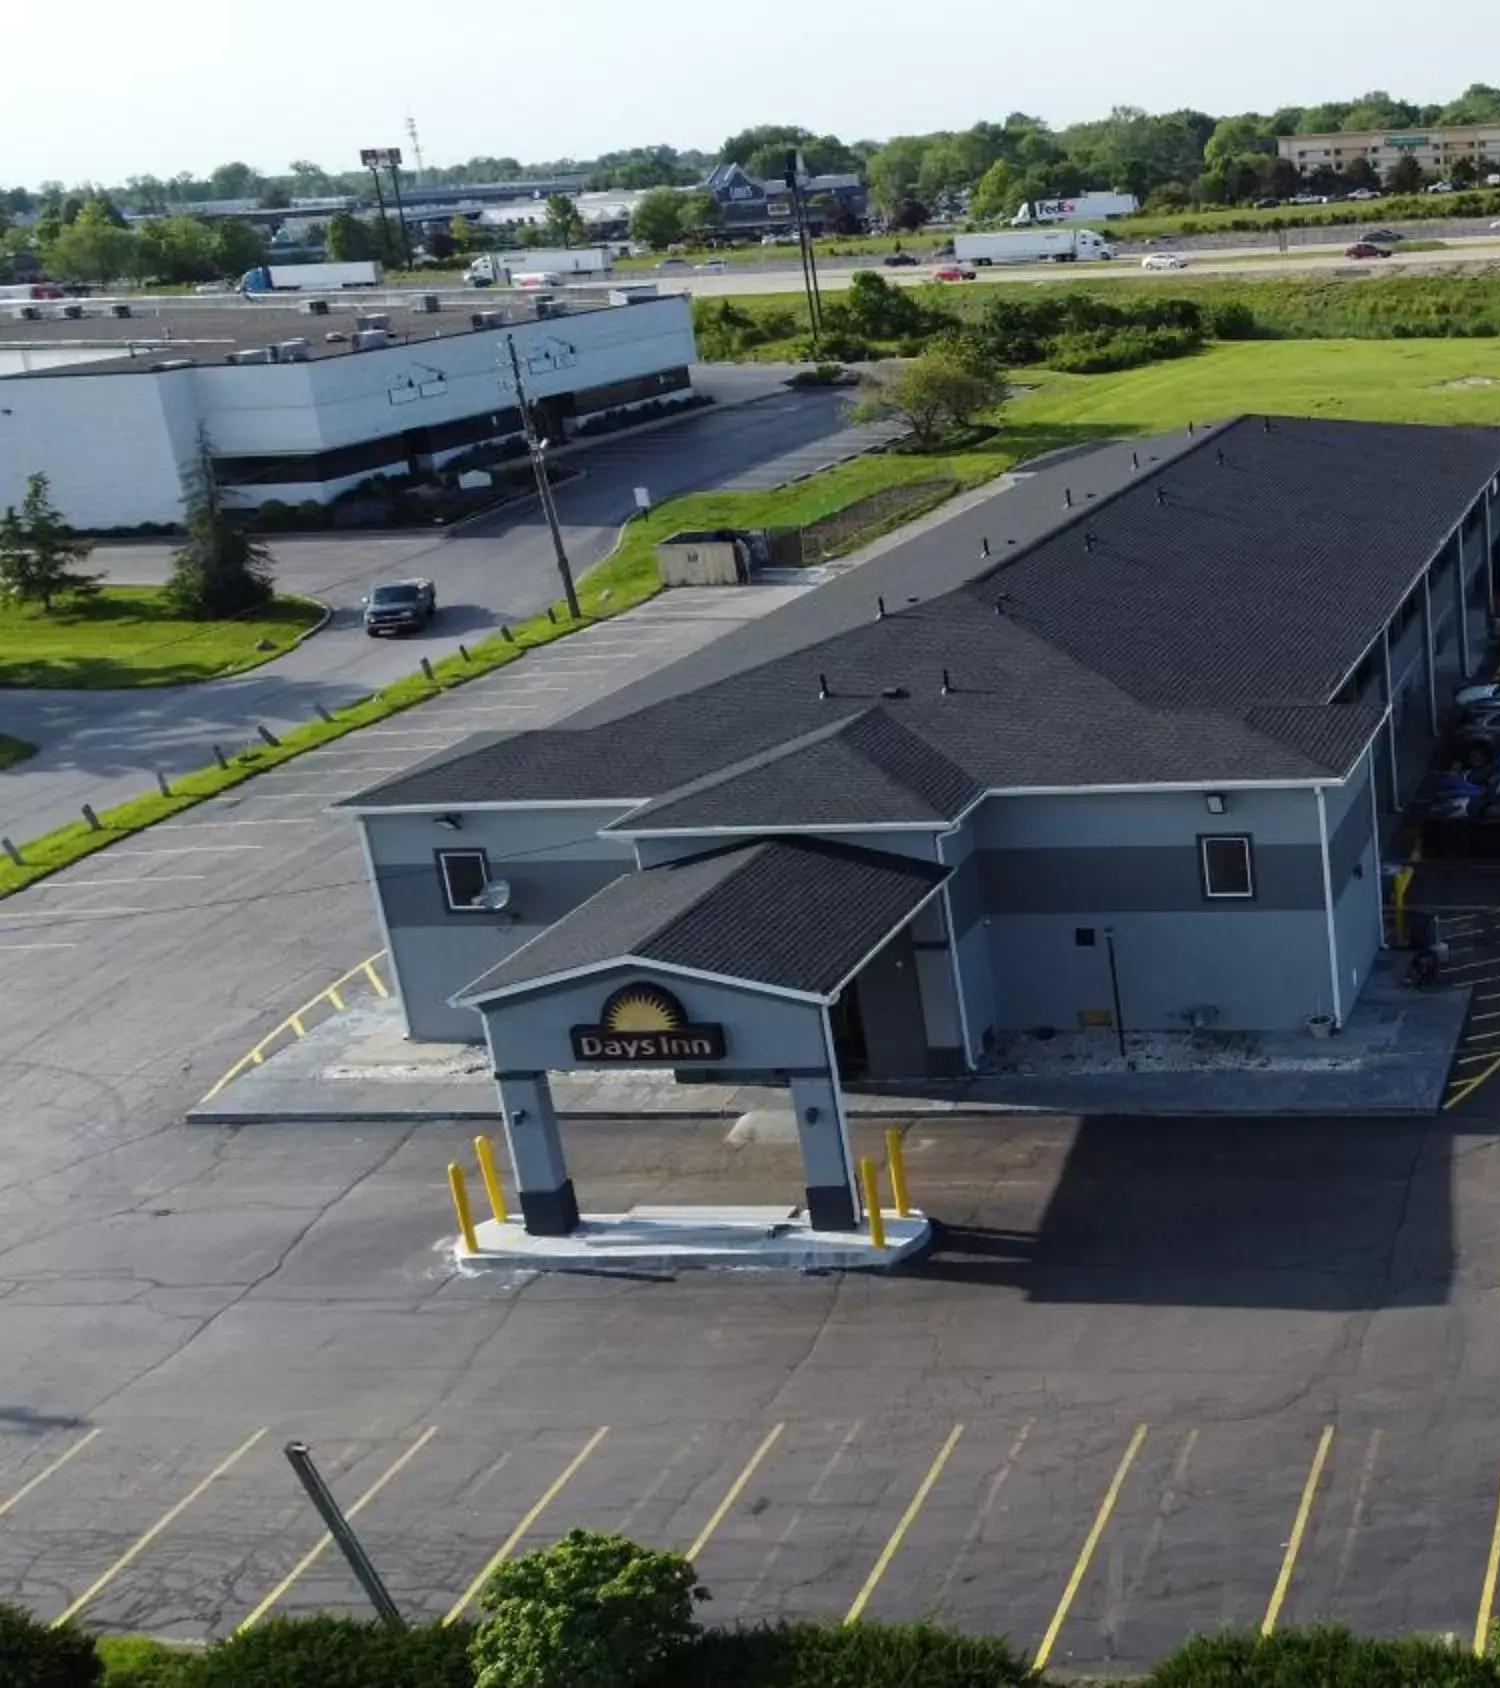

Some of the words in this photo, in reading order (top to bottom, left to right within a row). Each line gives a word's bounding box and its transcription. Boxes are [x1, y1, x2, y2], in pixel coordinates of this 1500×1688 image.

[1039, 201, 1075, 215] FedEx
[580, 1036, 656, 1058] Days
[660, 1035, 712, 1054] Inn
